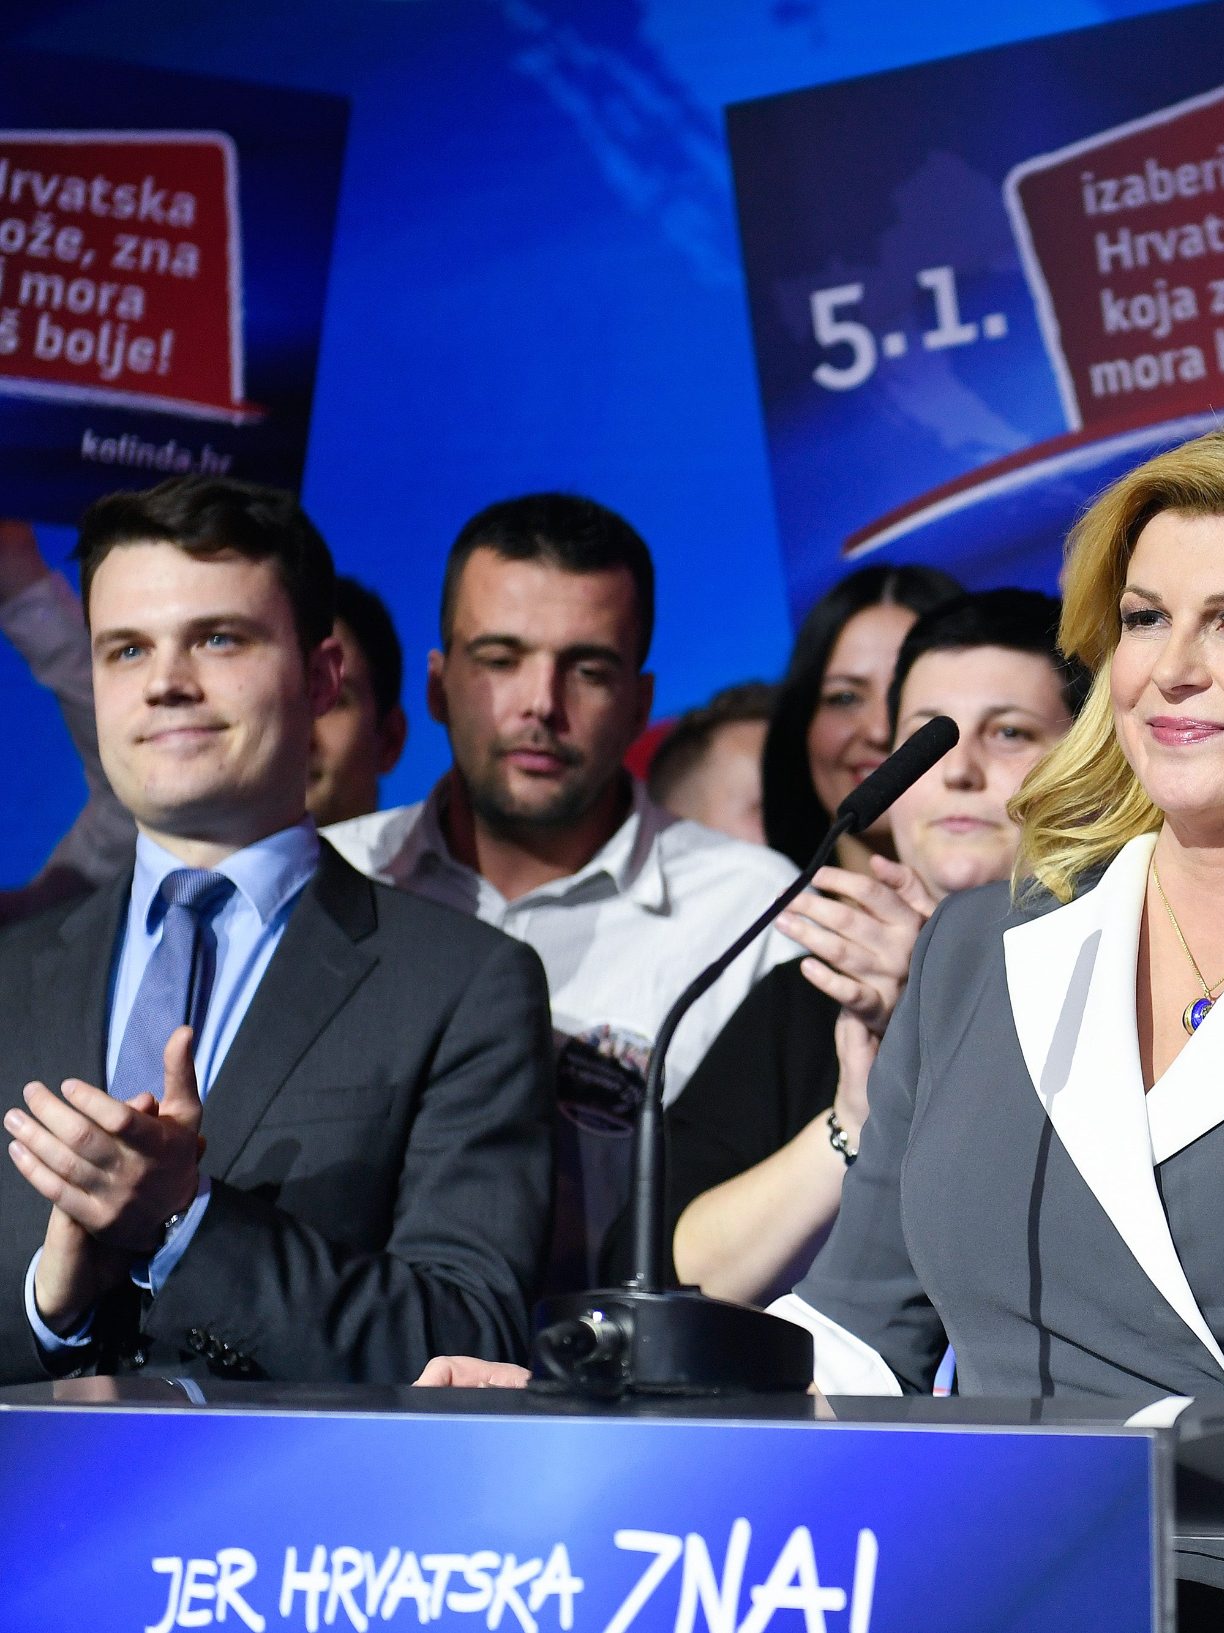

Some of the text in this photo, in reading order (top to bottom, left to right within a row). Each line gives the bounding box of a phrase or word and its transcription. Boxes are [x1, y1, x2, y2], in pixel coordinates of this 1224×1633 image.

[112, 232, 200, 280] zna
[19, 270, 146, 322] mora
[1101, 278, 1198, 339] koja
[34, 311, 175, 381] bolje!
[810, 266, 1009, 391] 5.1.
[1090, 345, 1207, 398] mora
[80, 427, 235, 476] kolinda.hr
[145, 1547, 266, 1633] JER
[279, 1542, 585, 1633] HRVATSKA
